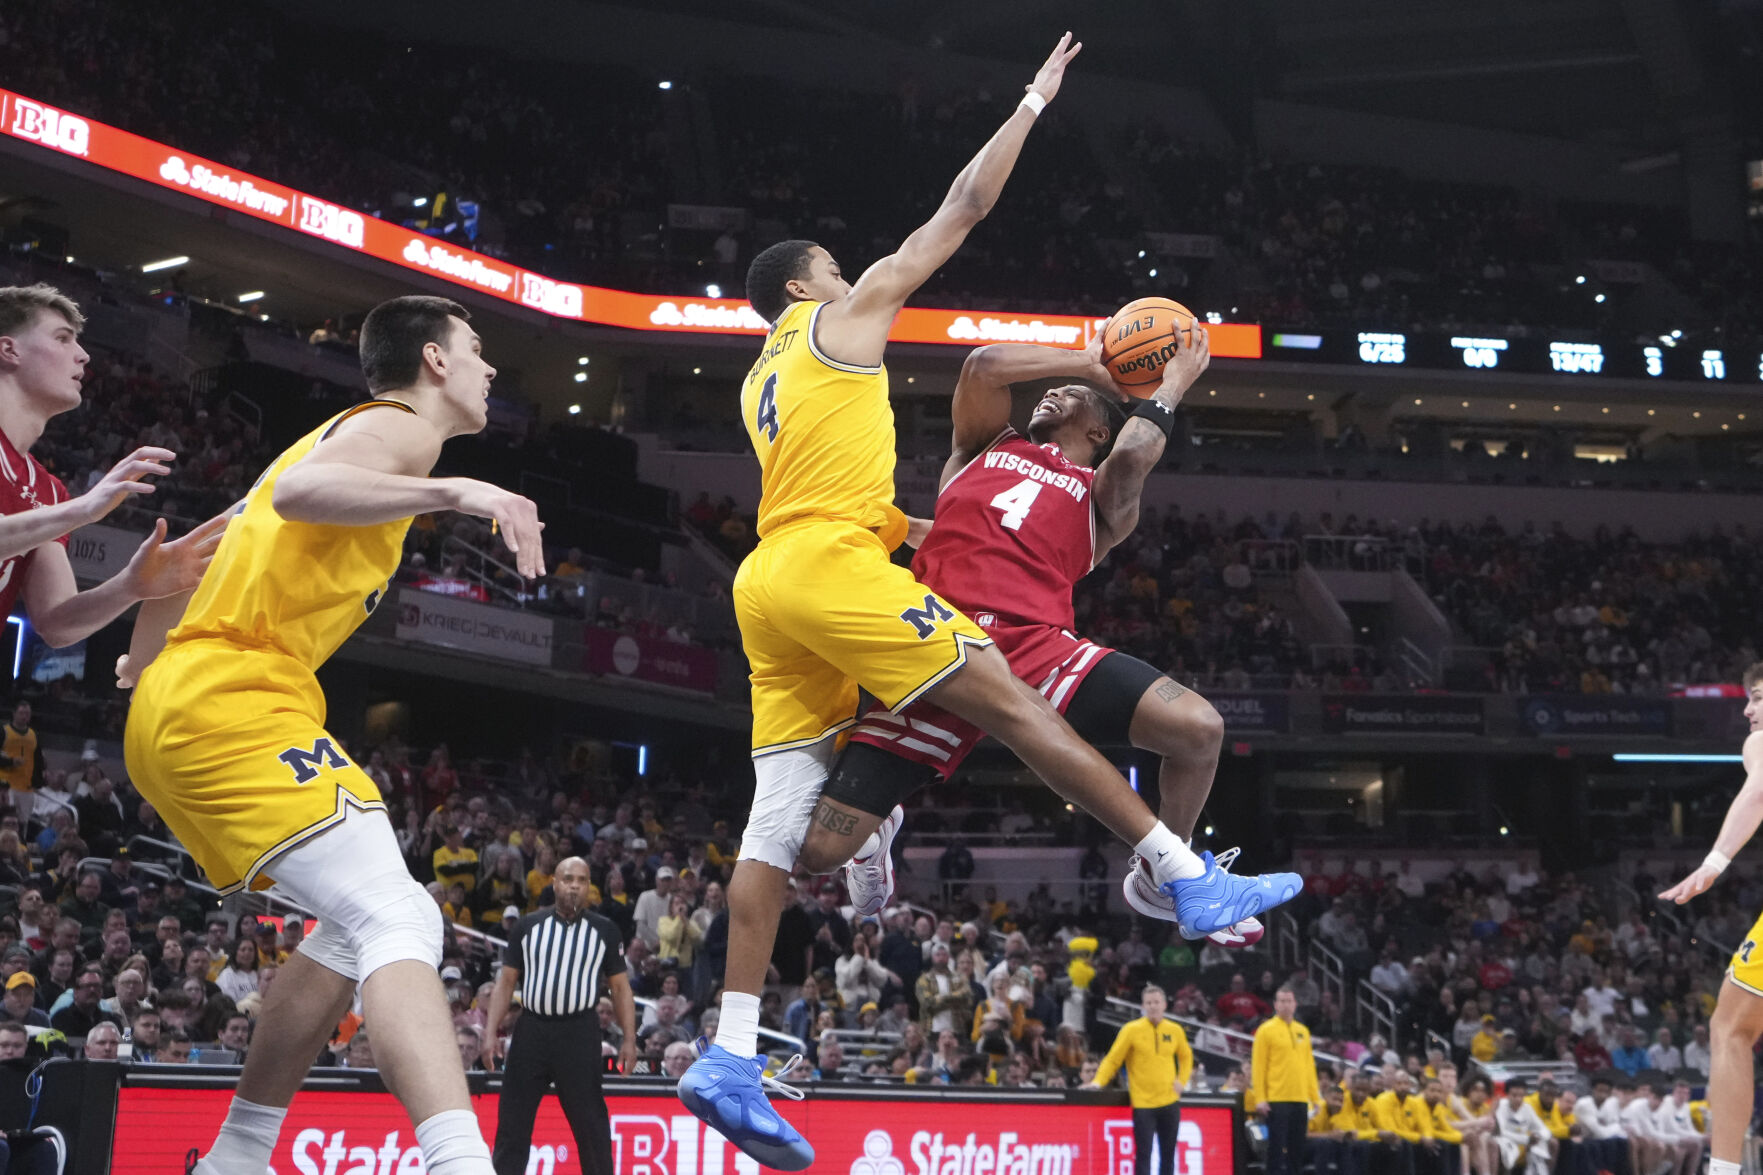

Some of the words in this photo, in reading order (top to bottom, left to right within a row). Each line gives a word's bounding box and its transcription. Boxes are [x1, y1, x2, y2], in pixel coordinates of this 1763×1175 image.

[750, 329, 799, 386] BURNETT
[1117, 342, 1178, 375] Wilson
[757, 371, 780, 447] 4
[984, 451, 1088, 503] WISCONSIN
[990, 478, 1043, 531] 4
[74, 538, 106, 561] 107.5
[900, 593, 956, 640] M
[277, 737, 350, 785] M
